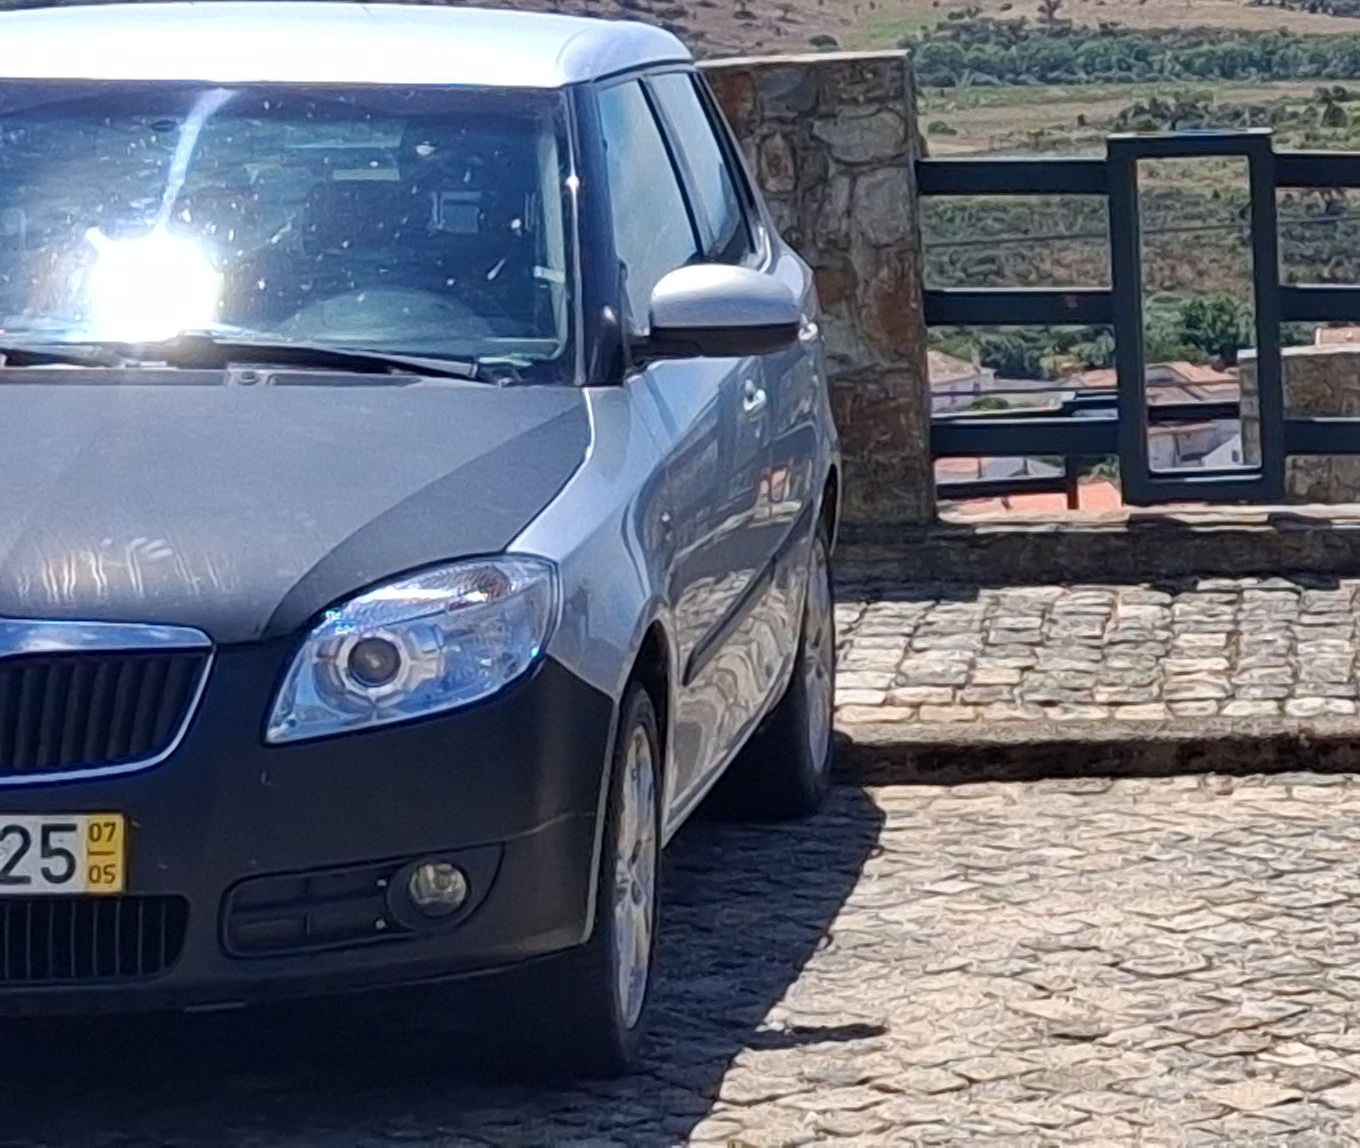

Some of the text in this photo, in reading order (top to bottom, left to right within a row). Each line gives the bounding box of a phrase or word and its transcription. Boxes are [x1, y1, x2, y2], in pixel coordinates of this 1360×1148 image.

[88, 822, 116, 842] 07
[0, 823, 78, 885] 25
[88, 864, 116, 884] 05
